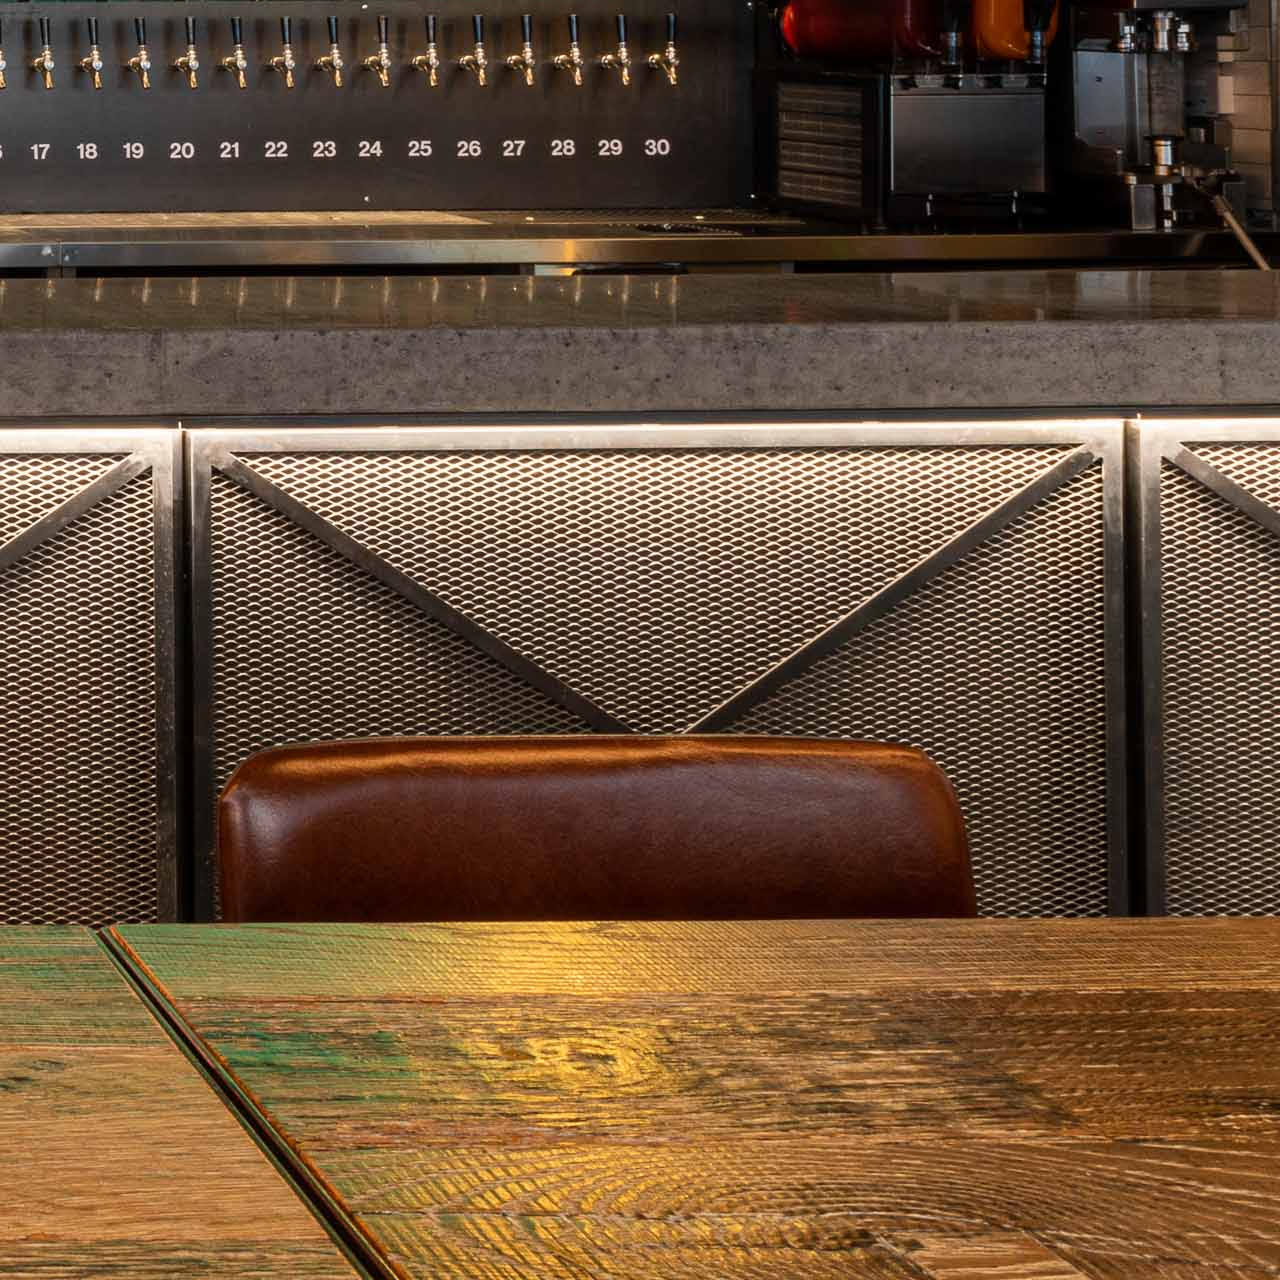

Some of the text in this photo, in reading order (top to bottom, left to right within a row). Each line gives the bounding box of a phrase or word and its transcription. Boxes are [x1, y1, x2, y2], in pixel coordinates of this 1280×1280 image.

[31, 144, 50, 159] 17
[170, 142, 194, 158] 20
[359, 141, 382, 156] 24
[645, 139, 669, 155] 30
